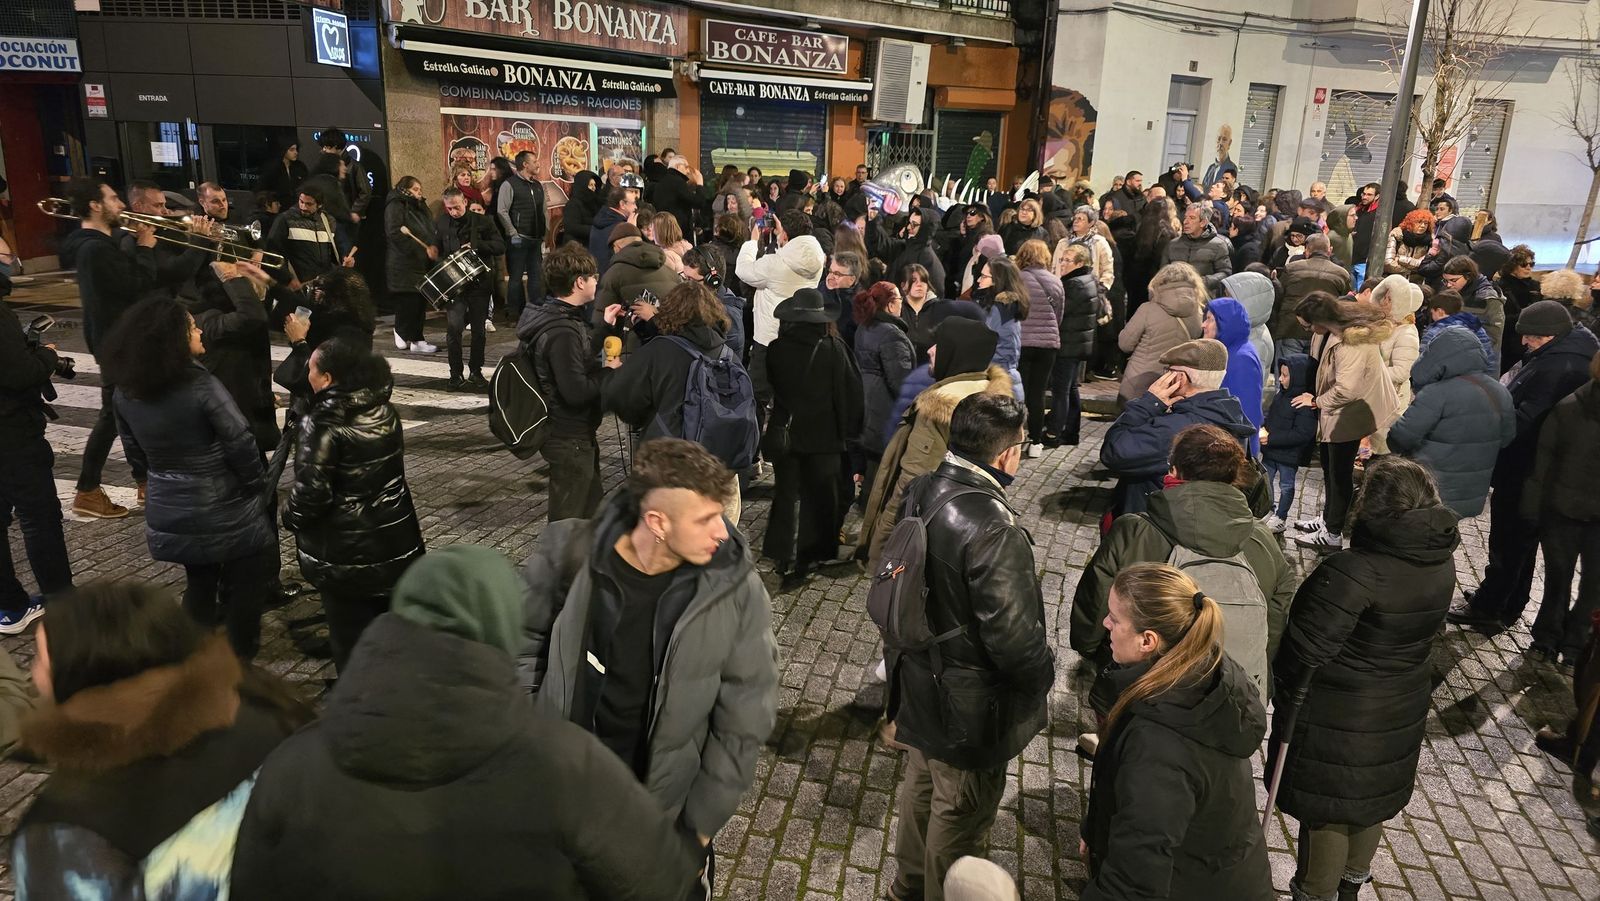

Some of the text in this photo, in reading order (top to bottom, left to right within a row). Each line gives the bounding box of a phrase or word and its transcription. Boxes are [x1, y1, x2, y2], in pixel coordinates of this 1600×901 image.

[465, 0, 678, 45] BAR BONANZA
[734, 28, 778, 44] CAFE
[791, 34, 824, 49] BAR
[711, 40, 843, 71] BONANZA
[423, 60, 655, 93] Estrella Galicia BONANZA Estrella Galicia
[138, 94, 169, 102] ENTRADA
[440, 85, 642, 111] COMBINADOS TAPAS RACIONES
[709, 81, 862, 102] CAFE-BAR BONANZA Estrella Galicia
[601, 135, 633, 146] DESAYUNOS
